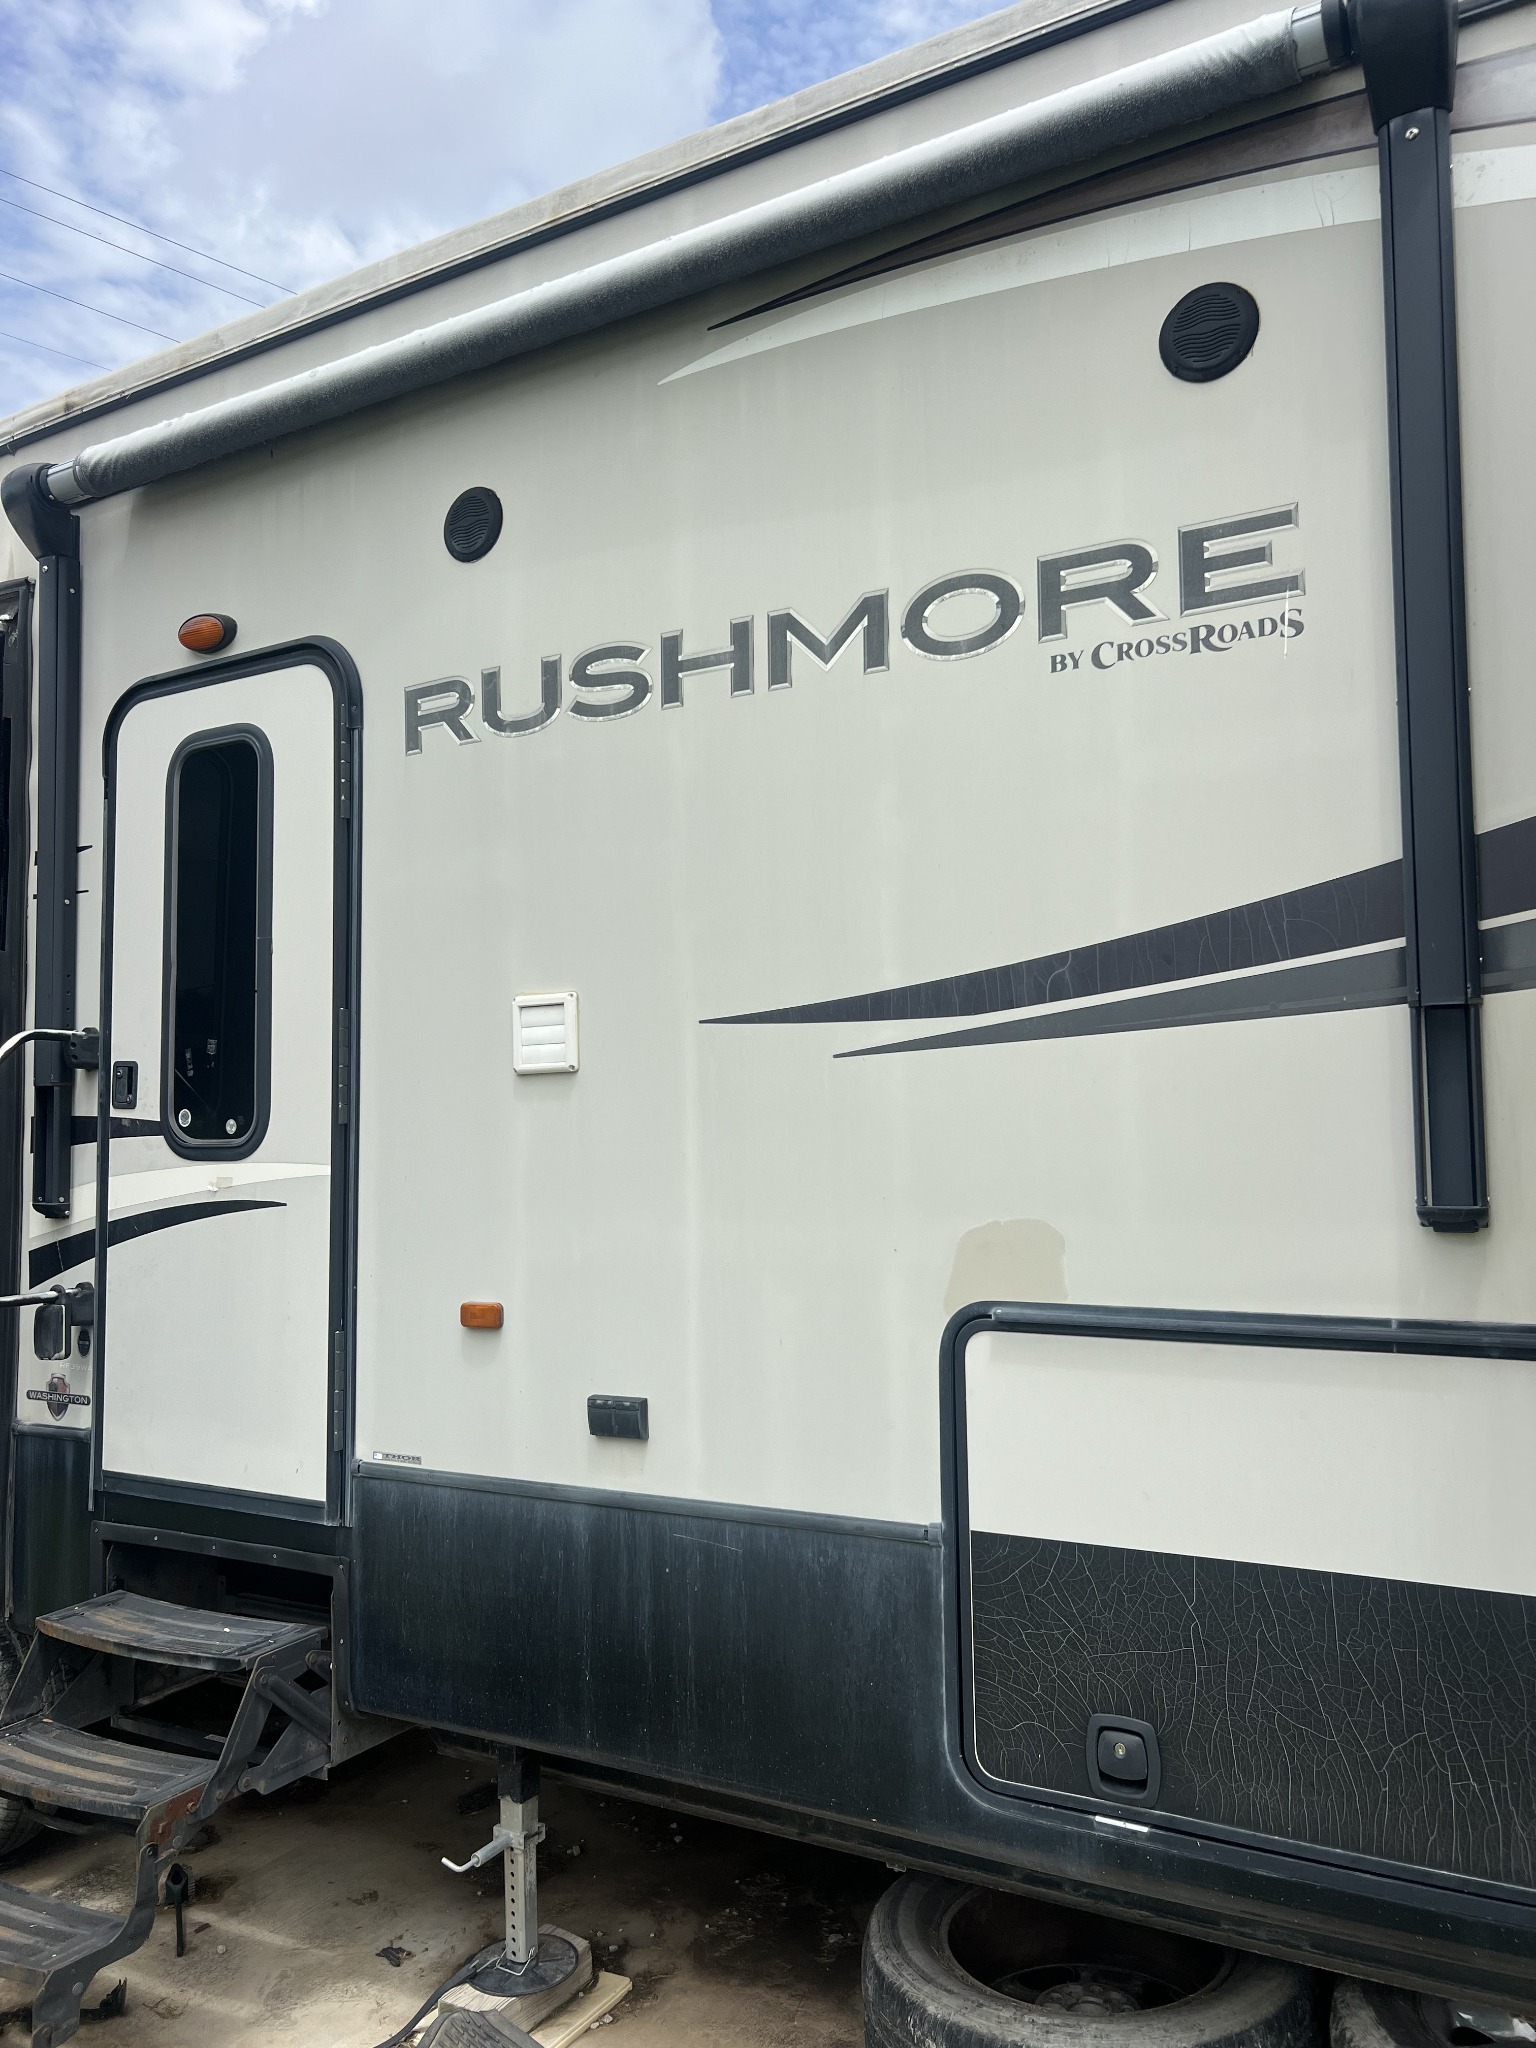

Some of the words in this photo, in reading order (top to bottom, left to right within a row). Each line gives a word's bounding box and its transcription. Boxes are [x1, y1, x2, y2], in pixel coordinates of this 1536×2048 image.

[404, 502, 1306, 757] RUSHMORE
[1050, 650, 1084, 674] BY
[29, 1391, 88, 1404] WASHINGTON
